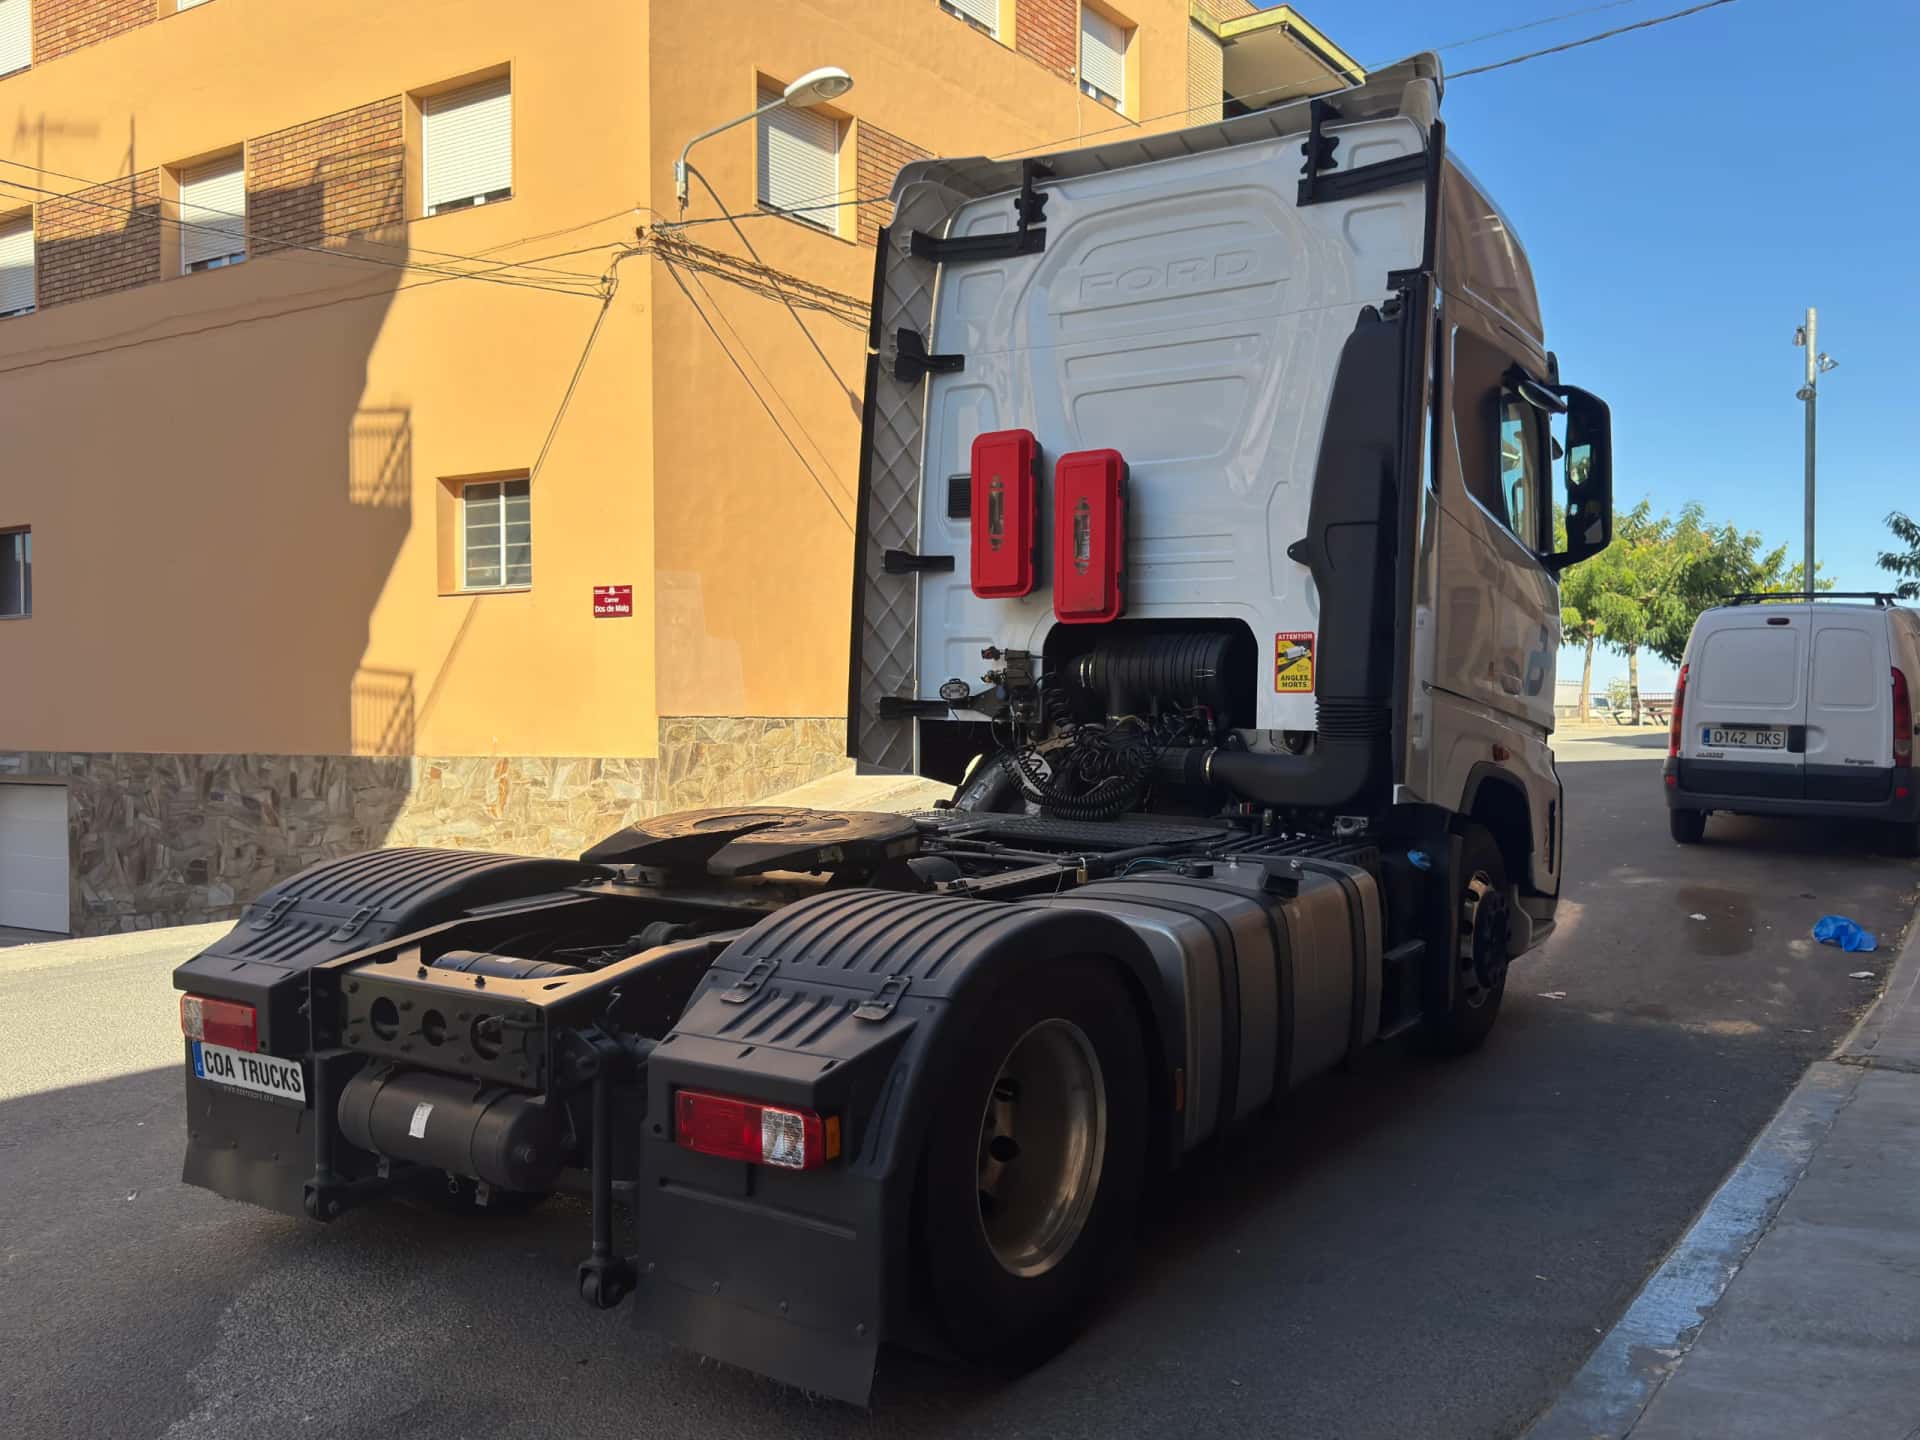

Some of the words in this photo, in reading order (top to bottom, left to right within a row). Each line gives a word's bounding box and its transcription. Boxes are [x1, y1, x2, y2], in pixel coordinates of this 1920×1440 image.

[1078, 250, 1257, 304] FORD
[607, 604, 615, 612] de
[616, 604, 629, 612] Maig
[1714, 731, 1747, 745] 0142
[1756, 732, 1781, 746] DKS
[204, 1050, 236, 1079] COA
[238, 1057, 302, 1093] TRUCKS
